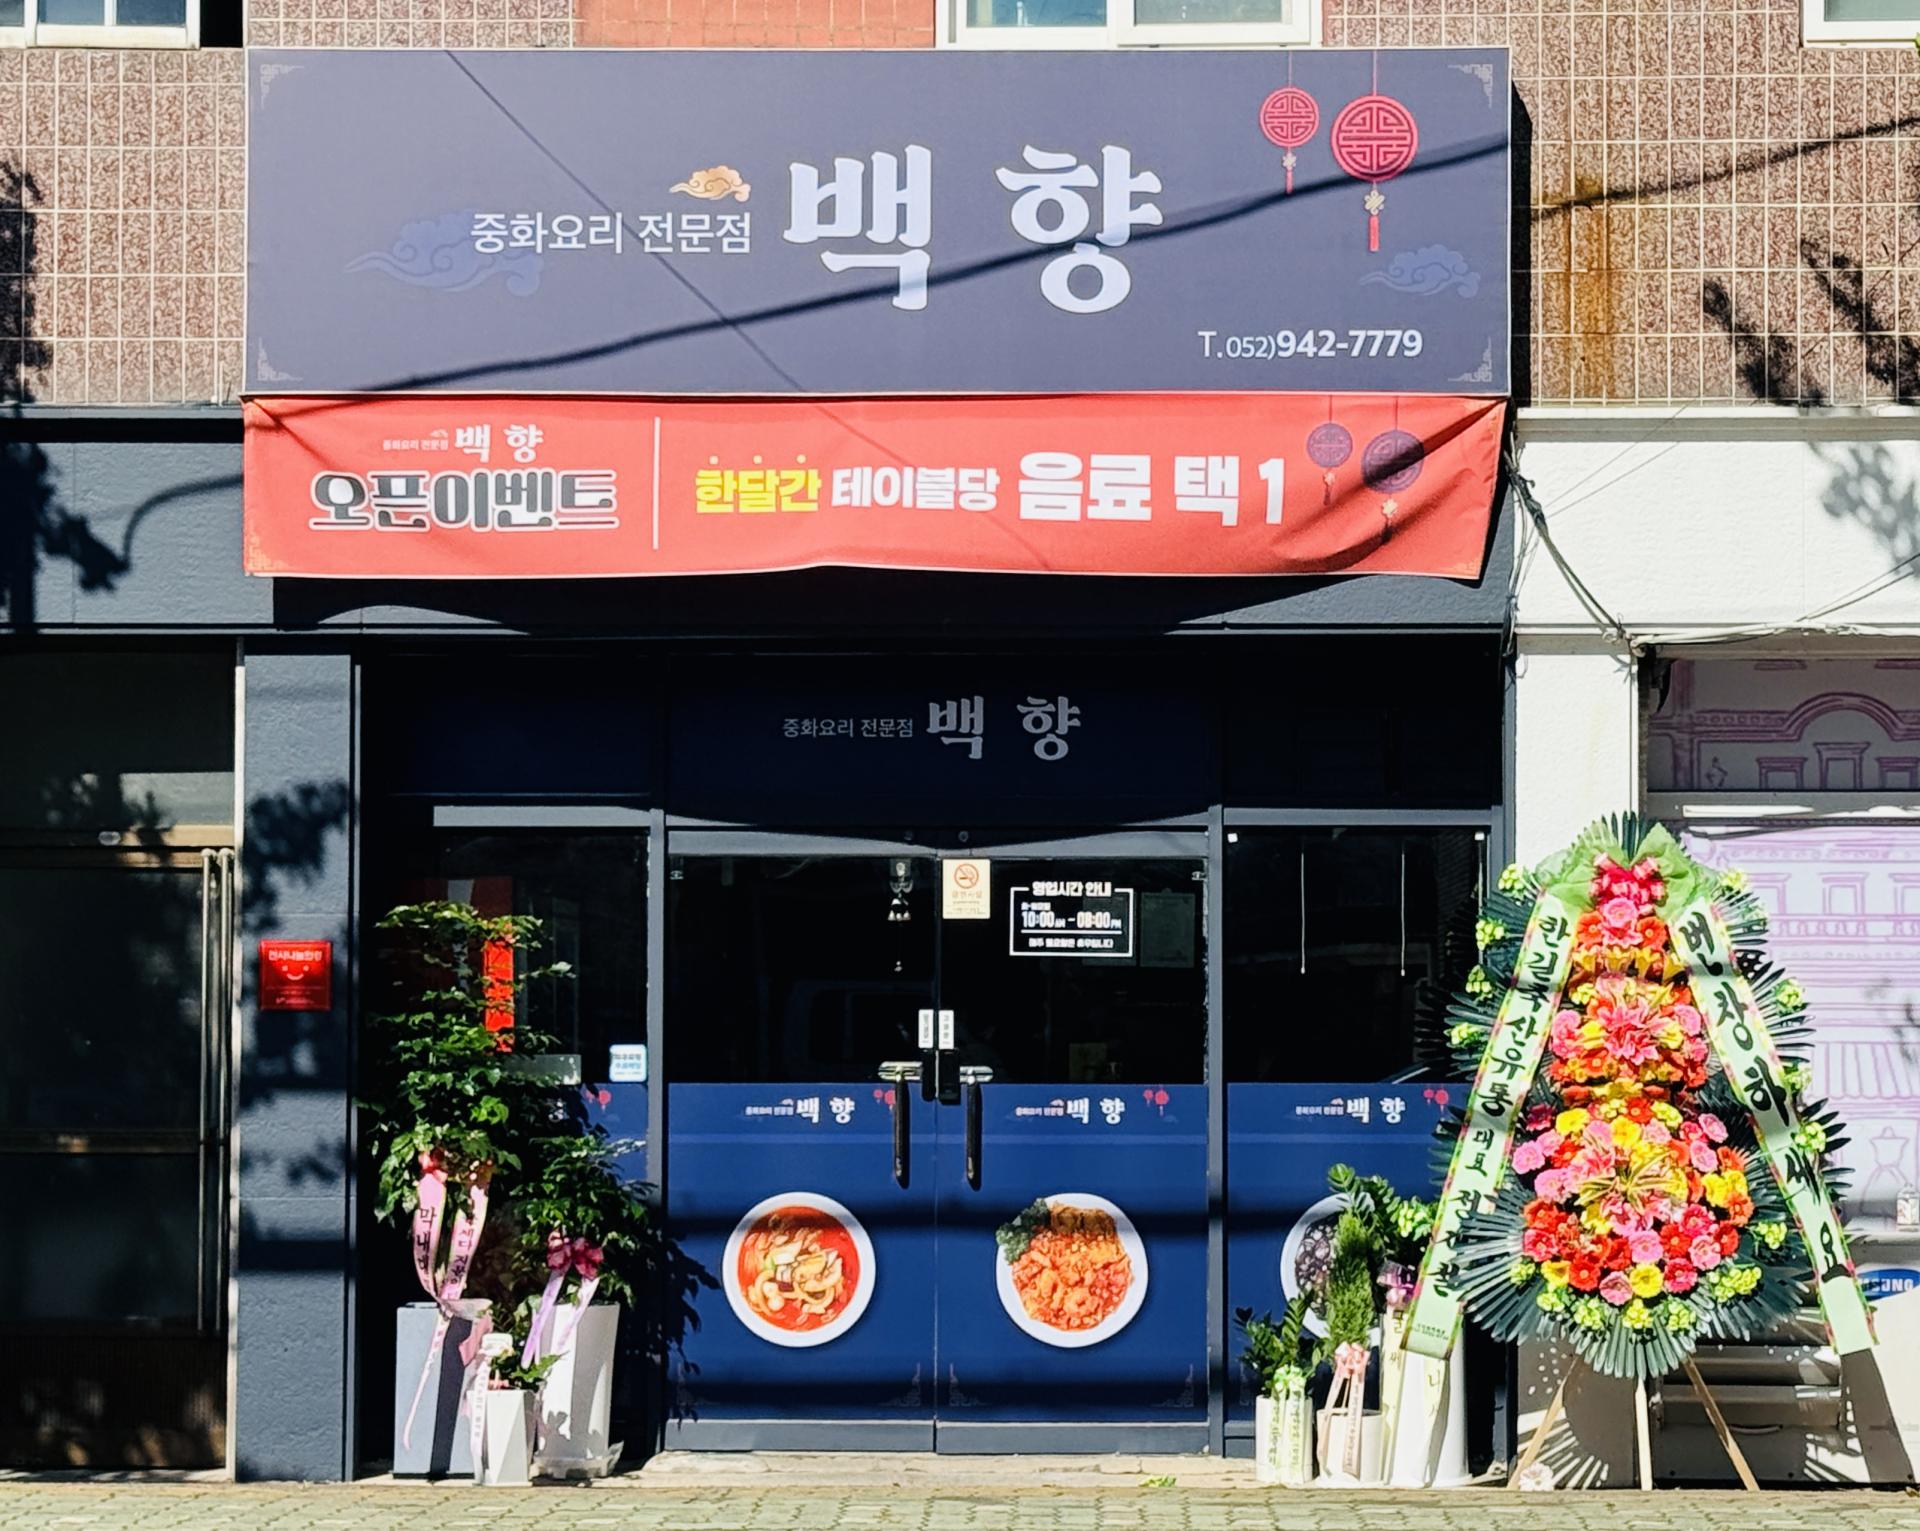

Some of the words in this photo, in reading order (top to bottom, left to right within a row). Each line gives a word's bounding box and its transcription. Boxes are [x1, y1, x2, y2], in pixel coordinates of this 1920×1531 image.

[470, 212, 623, 254] 중화요리
[638, 212, 752, 254] 전문점
[308, 467, 620, 532] 오픈이벤트
[695, 468, 822, 513] 한달간
[831, 465, 1001, 511] 테이블당
[1018, 450, 1152, 522] 음료
[1173, 454, 1240, 527] 택
[1257, 457, 1285, 525] 1
[783, 718, 854, 738] 중화요리
[860, 718, 913, 738] 전문점
[1032, 881, 1084, 897] 영업시간
[1085, 881, 1112, 897] 안내
